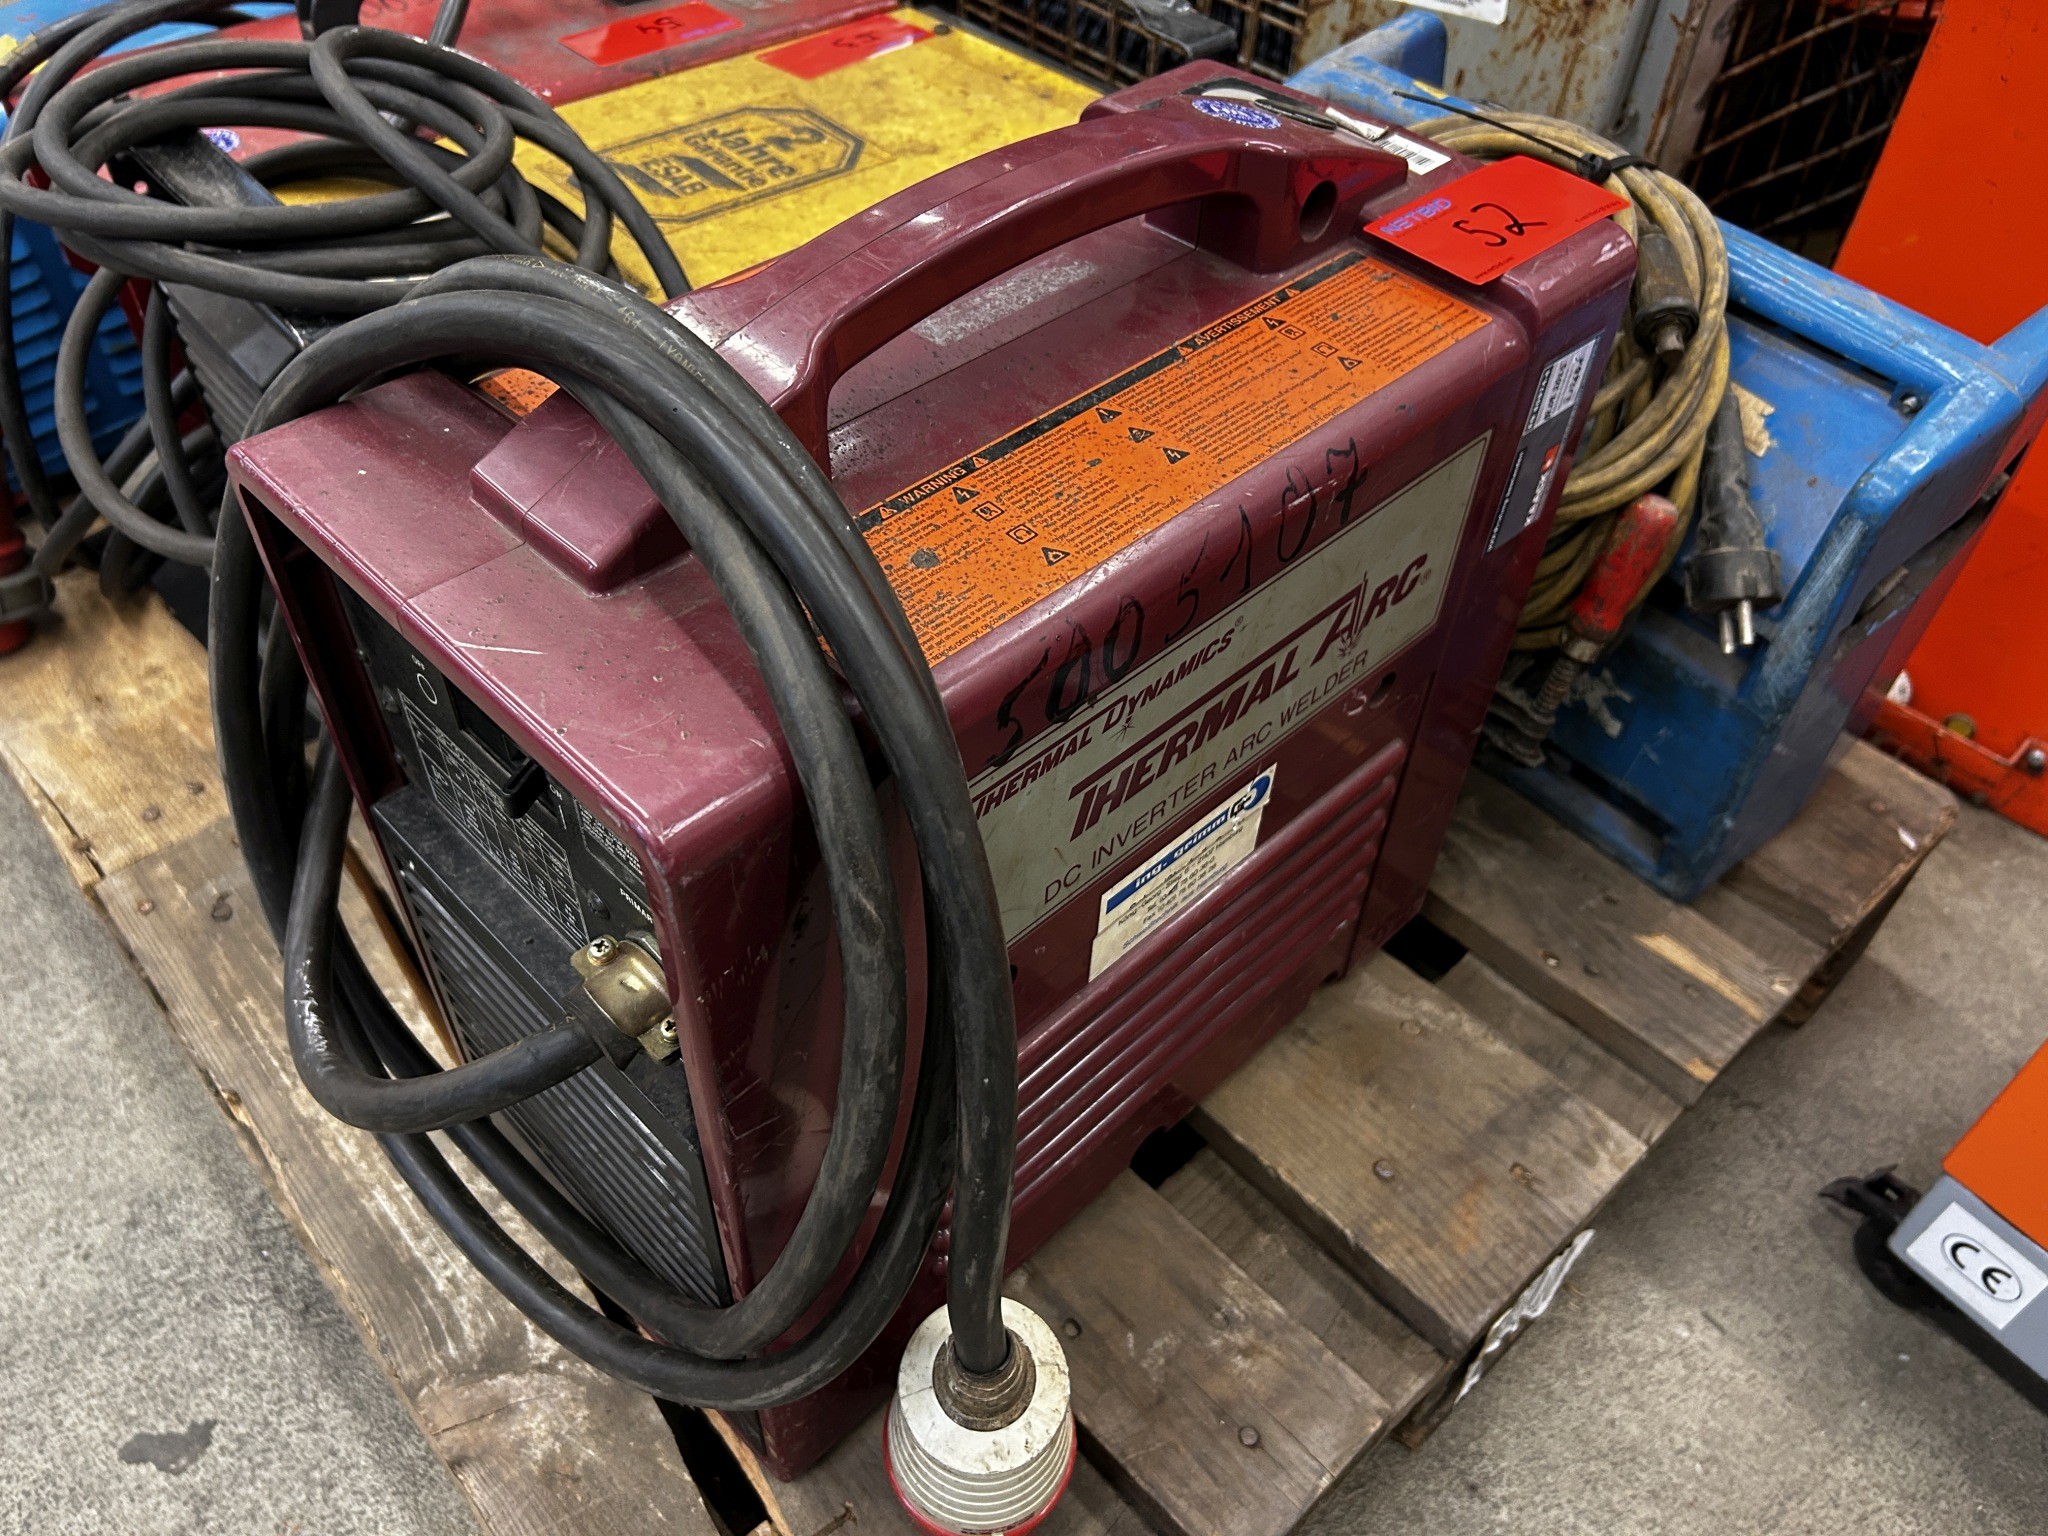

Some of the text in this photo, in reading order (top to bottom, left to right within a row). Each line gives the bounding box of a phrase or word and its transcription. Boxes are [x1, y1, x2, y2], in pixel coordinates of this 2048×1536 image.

[645, 156, 711, 196] ESAB
[708, 126, 797, 179] Jahre
[1380, 197, 1452, 236] NETBID
[1453, 202, 1547, 247] 52
[1192, 296, 1283, 344] AVERTISSEMENT
[897, 466, 968, 505] WARNING
[1068, 644, 1301, 843] THERMAL
[972, 726, 1092, 820] THERMAL
[1044, 866, 1082, 904] DC
[1091, 765, 1216, 866] INVERTER
[1223, 721, 1273, 770] ARC
[1279, 649, 1370, 728] WELDER
[1135, 815, 1226, 889] ing. grimm
[1951, 1241, 2012, 1295] CE
